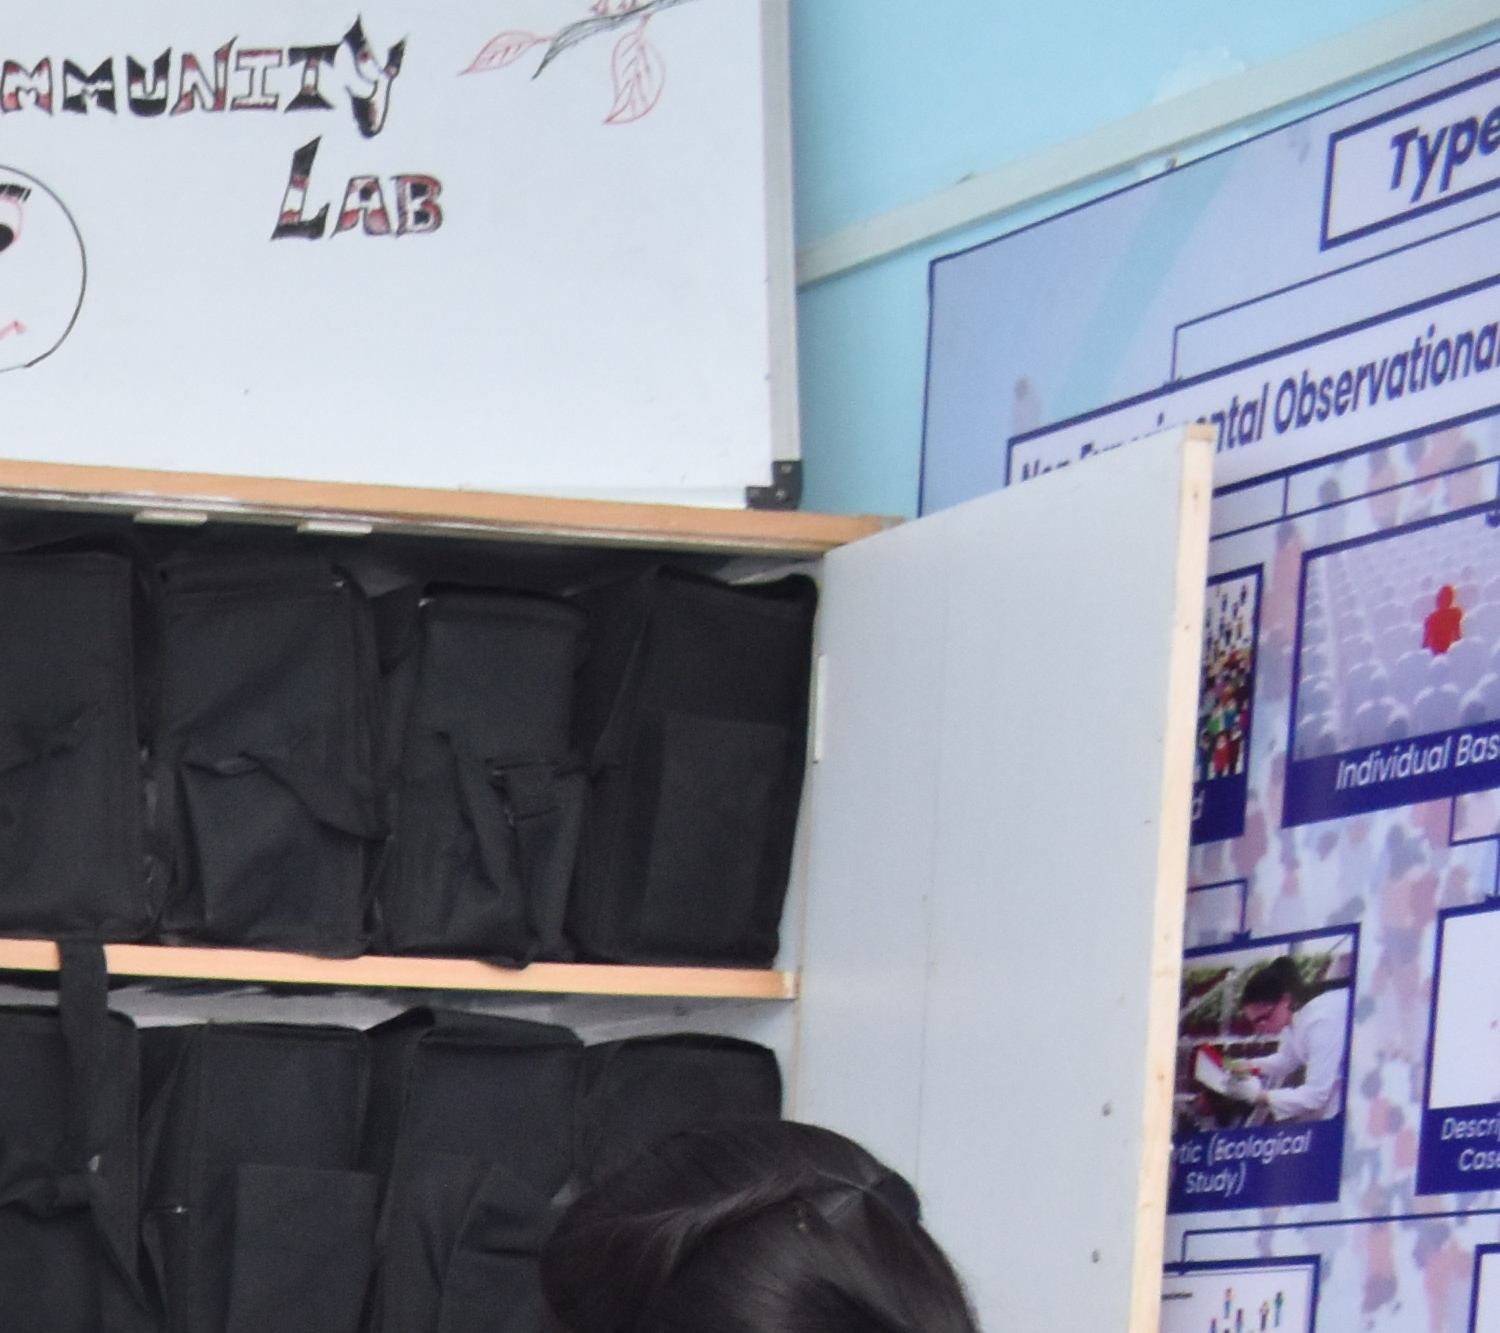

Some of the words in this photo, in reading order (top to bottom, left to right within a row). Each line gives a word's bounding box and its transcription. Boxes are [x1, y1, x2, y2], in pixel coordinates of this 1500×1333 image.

[271, 135, 443, 240] LAB
[1274, 320, 1500, 435] Observationa
[1335, 736, 1452, 791] Individual
[1207, 1131, 1312, 1166] (Ecological
[1185, 1163, 1247, 1197] Study)
